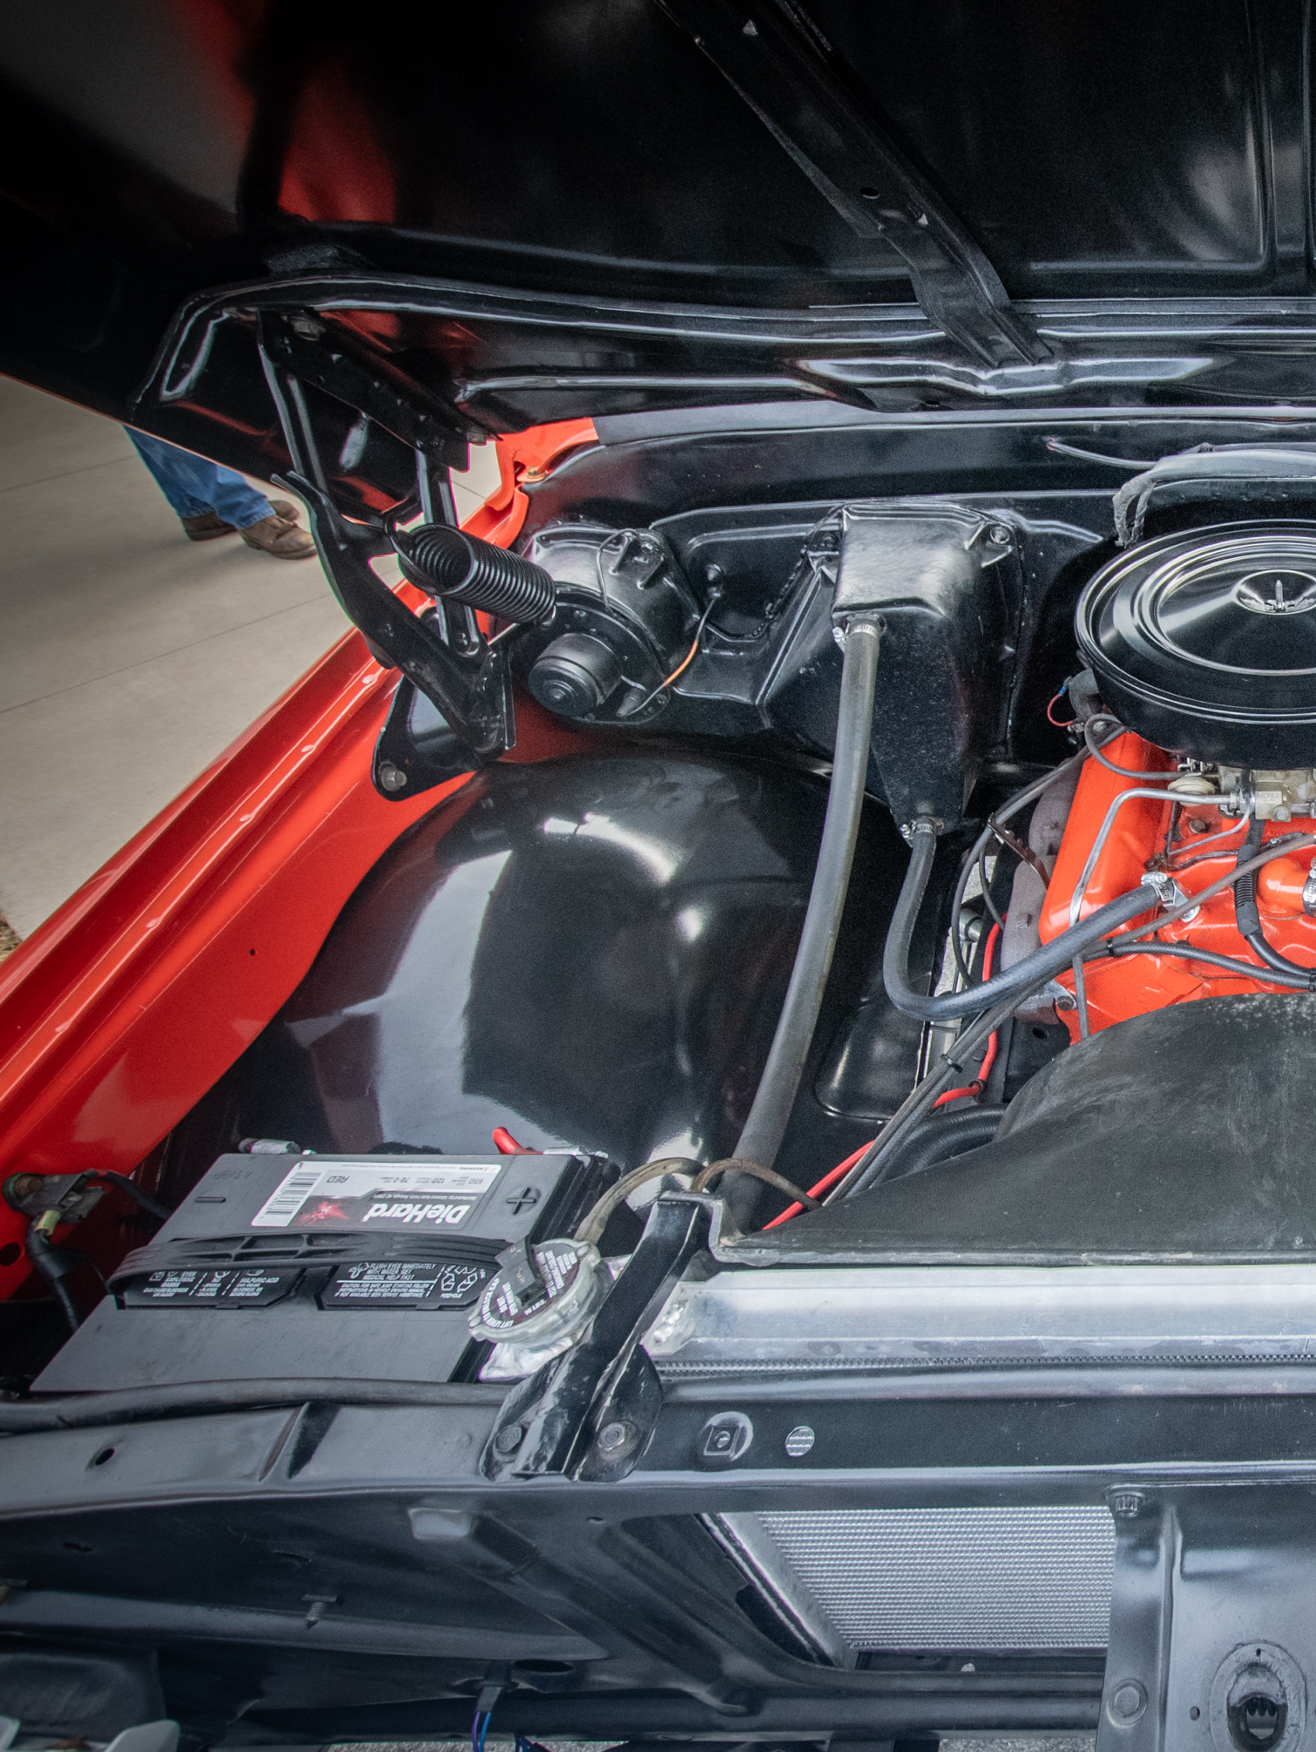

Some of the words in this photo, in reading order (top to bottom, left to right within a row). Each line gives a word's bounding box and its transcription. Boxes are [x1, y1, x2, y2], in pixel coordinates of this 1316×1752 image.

[326, 1175, 350, 1183] RED
[361, 1202, 471, 1225] DieHard
[488, 1277, 499, 1290] CAP
[501, 1282, 511, 1293] HOT
[482, 1291, 493, 1315] UNLOCK
[496, 1295, 506, 1305] NOT
[504, 1289, 516, 1305] WHEN
[498, 1303, 508, 1314] DO
[507, 1301, 519, 1316] OPEN
[485, 1315, 502, 1328] LEVER
[499, 1320, 514, 1328] LIFT
